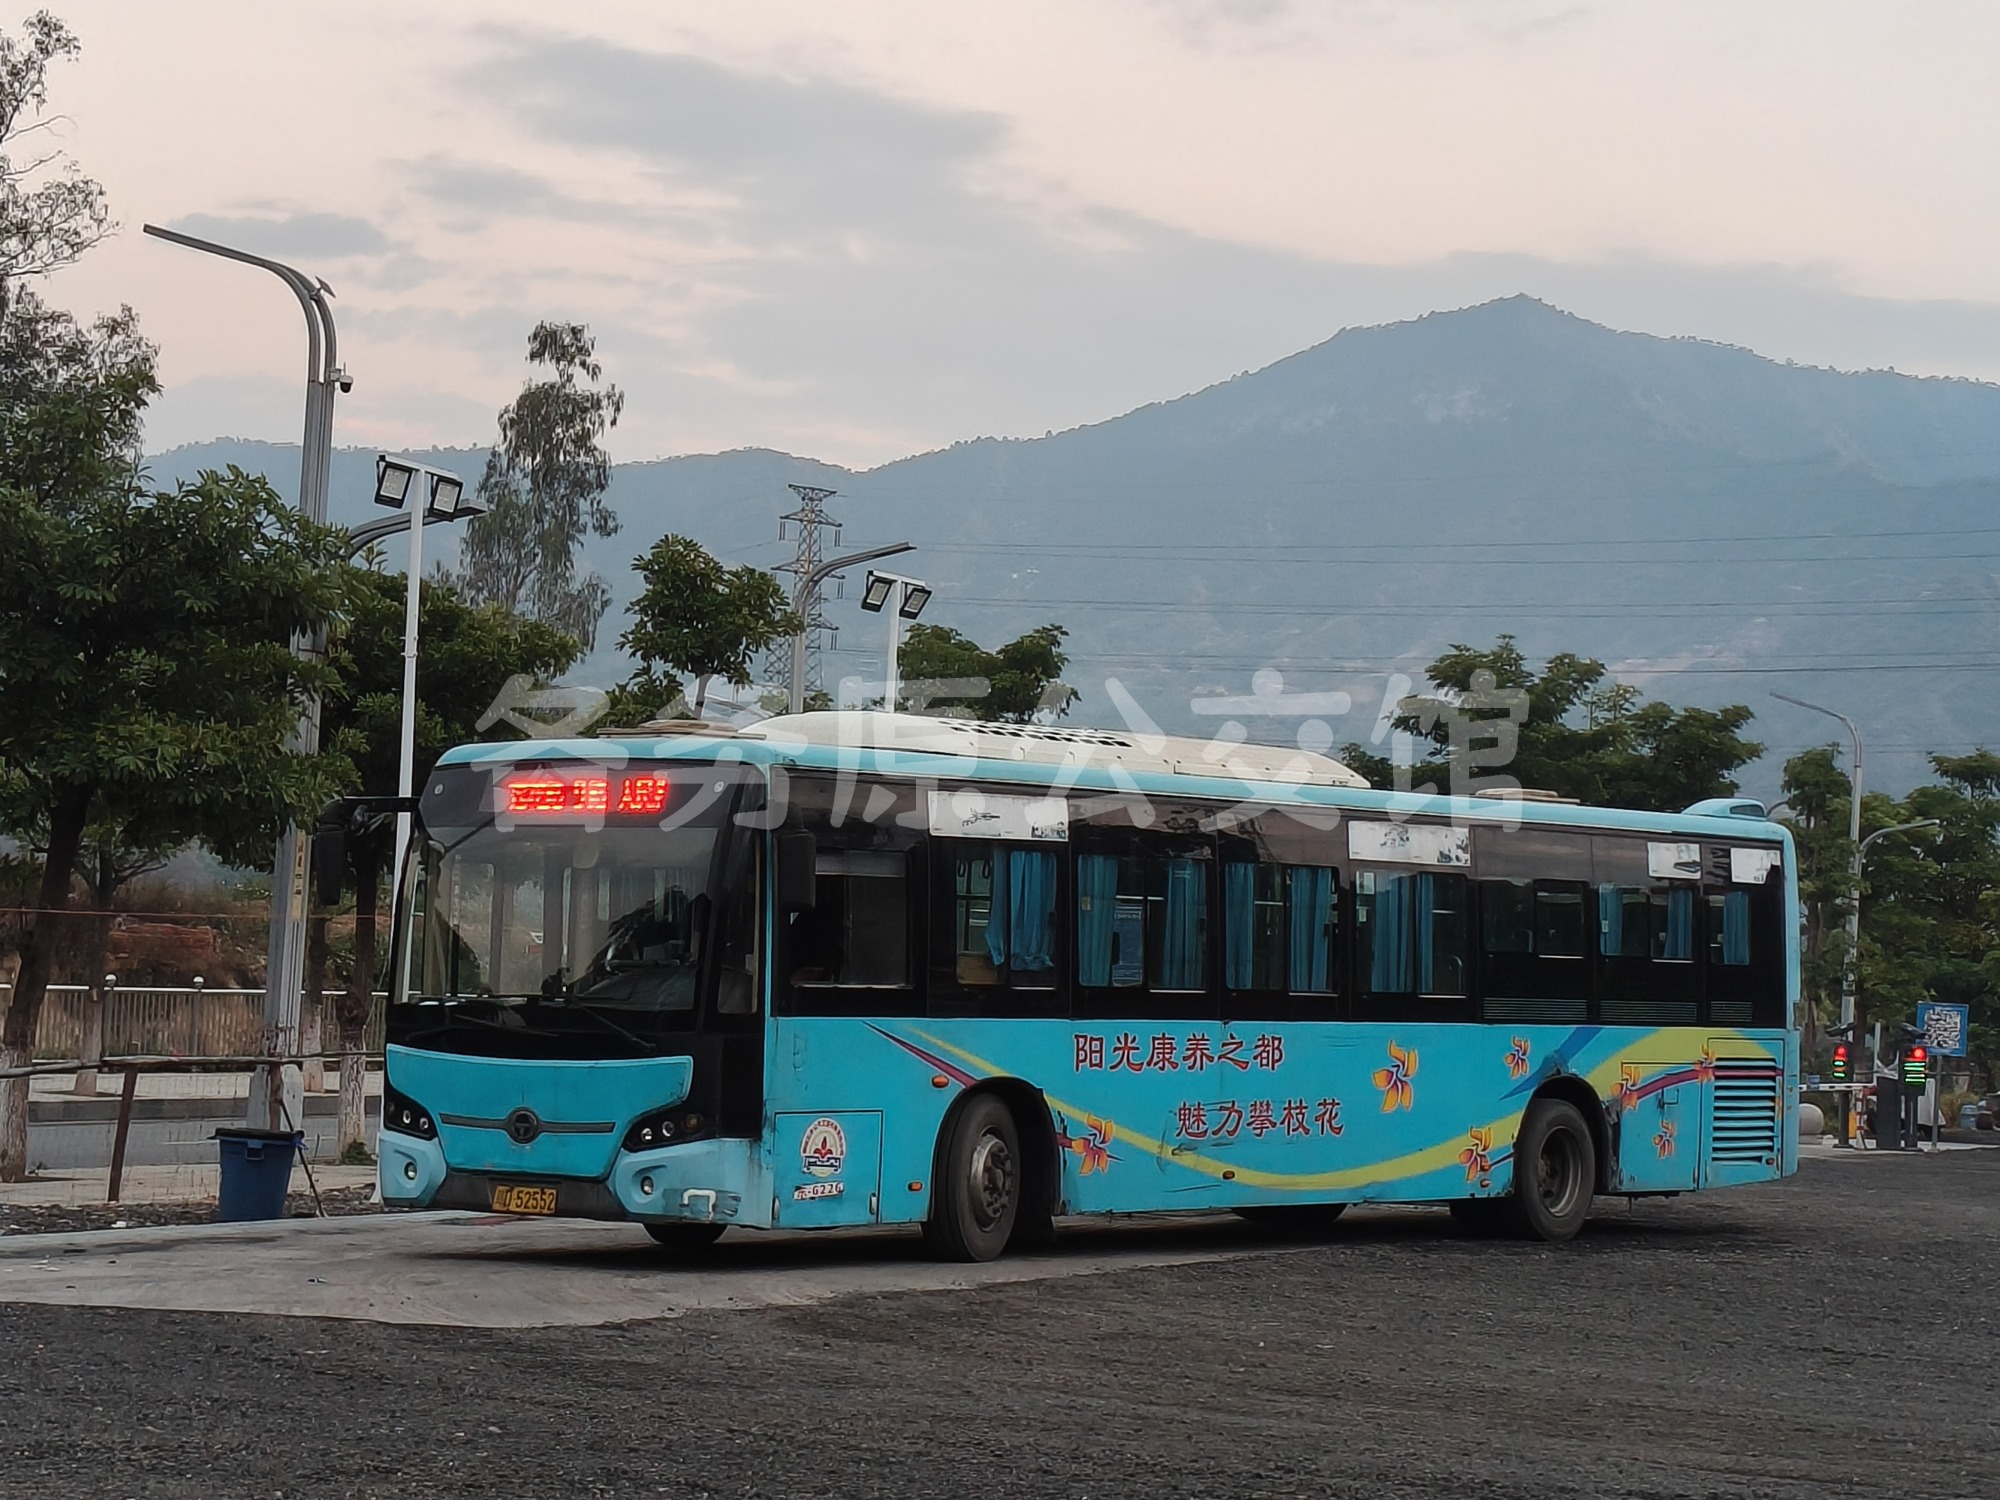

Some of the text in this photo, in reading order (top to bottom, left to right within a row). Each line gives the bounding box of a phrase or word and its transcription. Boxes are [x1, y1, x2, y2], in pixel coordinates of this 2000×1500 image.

[1073, 1032, 1284, 1073] 阳光康养之都
[1175, 1098, 1344, 1138] 魅力攀枝花
